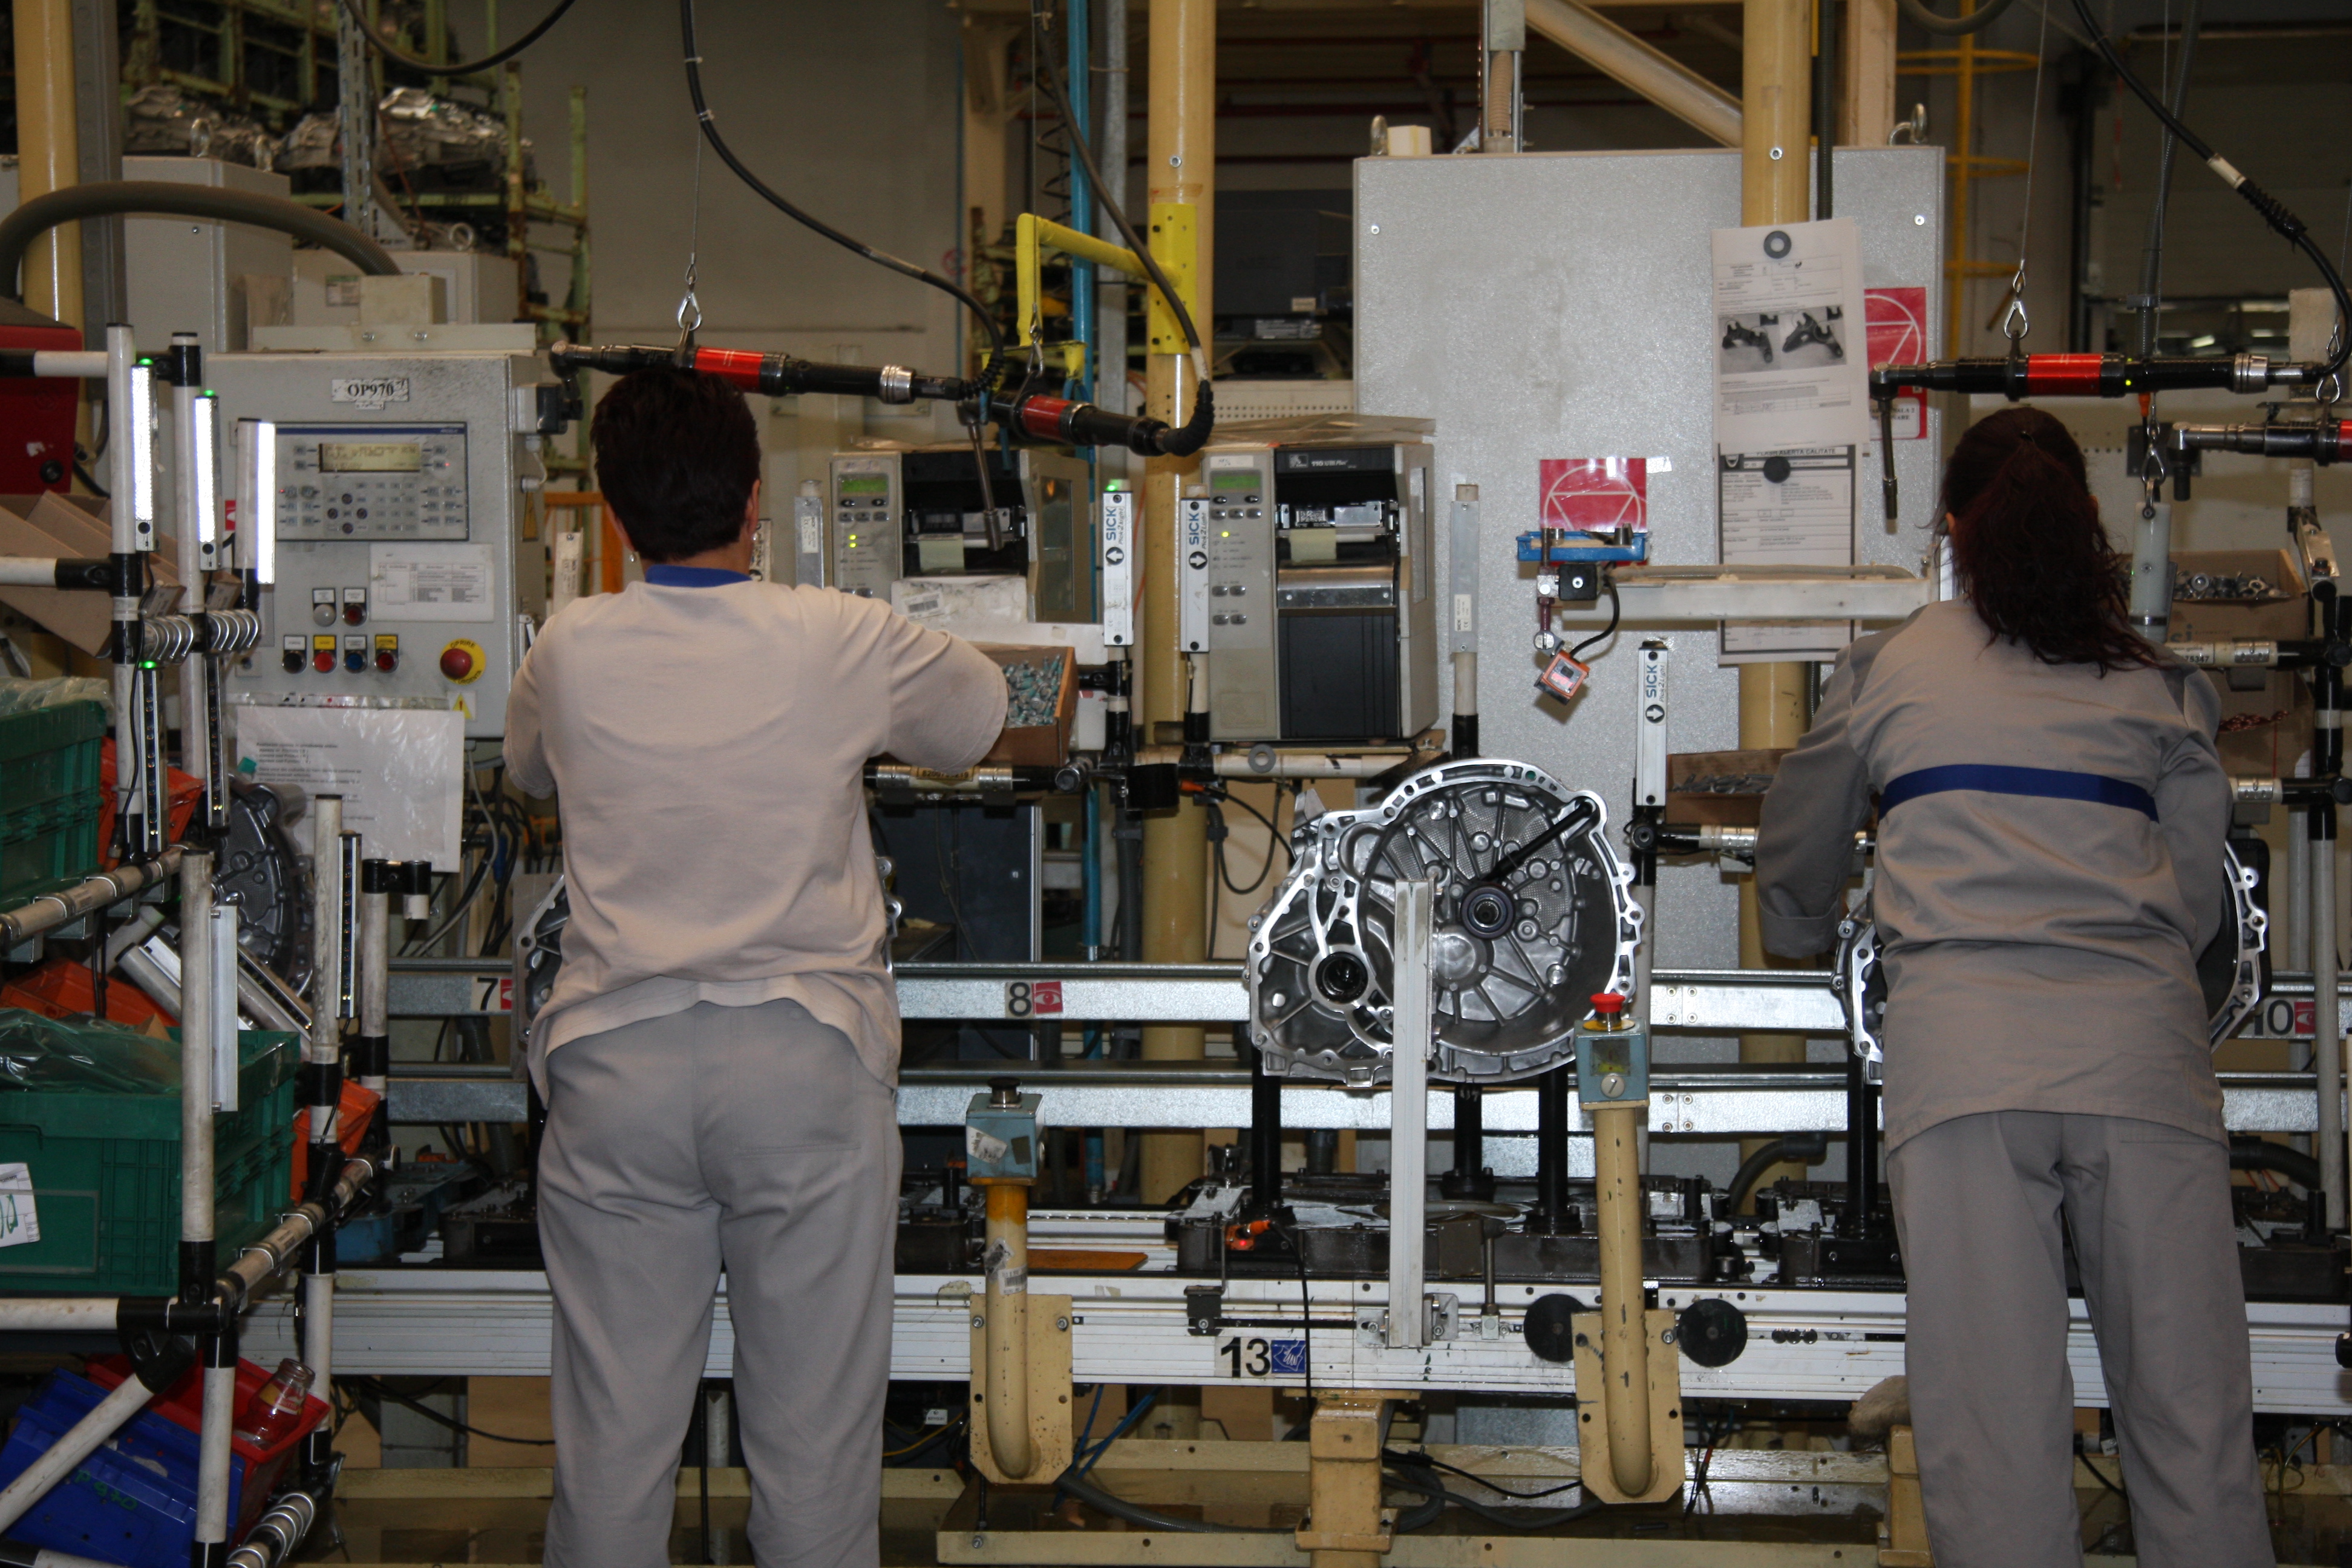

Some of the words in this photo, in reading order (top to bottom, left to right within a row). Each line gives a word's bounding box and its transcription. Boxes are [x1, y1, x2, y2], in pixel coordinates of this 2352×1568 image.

[347, 382, 394, 397] OP970
[1106, 508, 1117, 541] SICK
[1189, 512, 1200, 546] SICK
[1646, 664, 1658, 698] SICK
[477, 978, 499, 1011] 7
[1008, 981, 1032, 1017] 8
[2253, 1000, 2294, 1036] 10
[1220, 1337, 1271, 1378] 13
